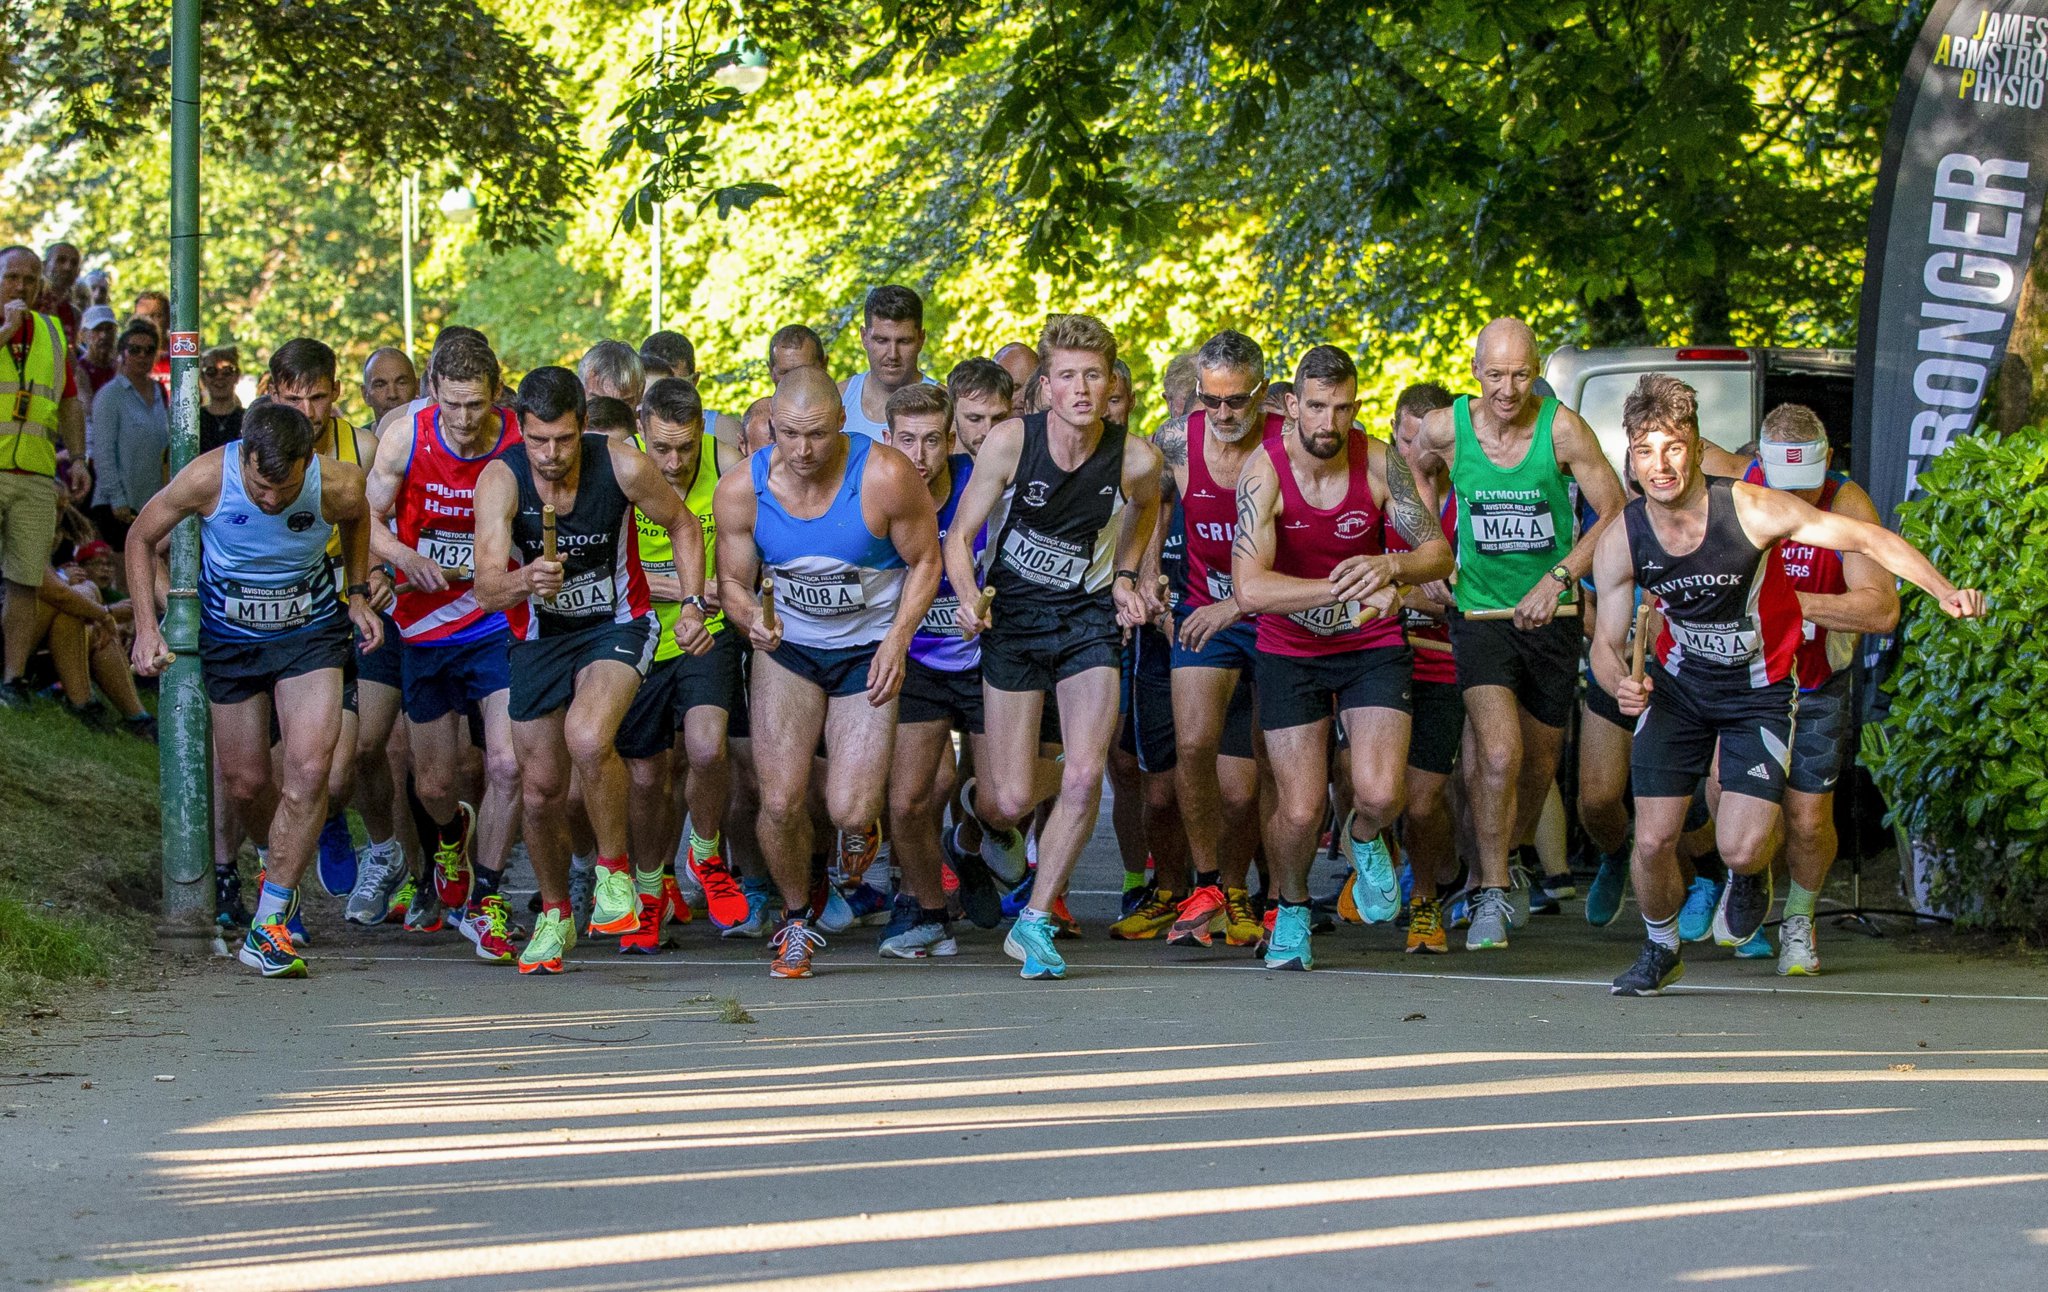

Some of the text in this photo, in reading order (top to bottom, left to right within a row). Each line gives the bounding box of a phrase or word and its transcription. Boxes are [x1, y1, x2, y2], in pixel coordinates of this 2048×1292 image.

[1972, 10, 2048, 49] JAMES
[1933, 33, 2048, 81] ARMSTRO
[1958, 68, 2045, 109] PHYSIO
[425, 483, 475, 498] Plym
[1475, 488, 1540, 500] PLYMOUTH
[1481, 503, 1536, 512] TAVISTOCK RELAYS
[434, 529, 467, 539] TAVISTOCK
[1196, 522, 1238, 541] CRI
[1482, 517, 1544, 540] M44 A
[526, 533, 611, 549] TASTOCK
[1028, 528, 1059, 547] TAVISTOCK
[1059, 541, 1083, 552] RELAYS
[429, 542, 472, 567] M32
[1014, 539, 1059, 573] M05
[1056, 558, 1075, 579] A
[240, 585, 299, 596] TAVISTOCK RELAYS
[591, 584, 607, 604] A
[788, 582, 854, 606] M08 A
[1650, 573, 1744, 596] TAVISTOCK
[238, 600, 301, 620] M11 A
[1337, 602, 1350, 622] A
[1714, 621, 1740, 630] RELAYS
[1684, 631, 1748, 654] M43 A
